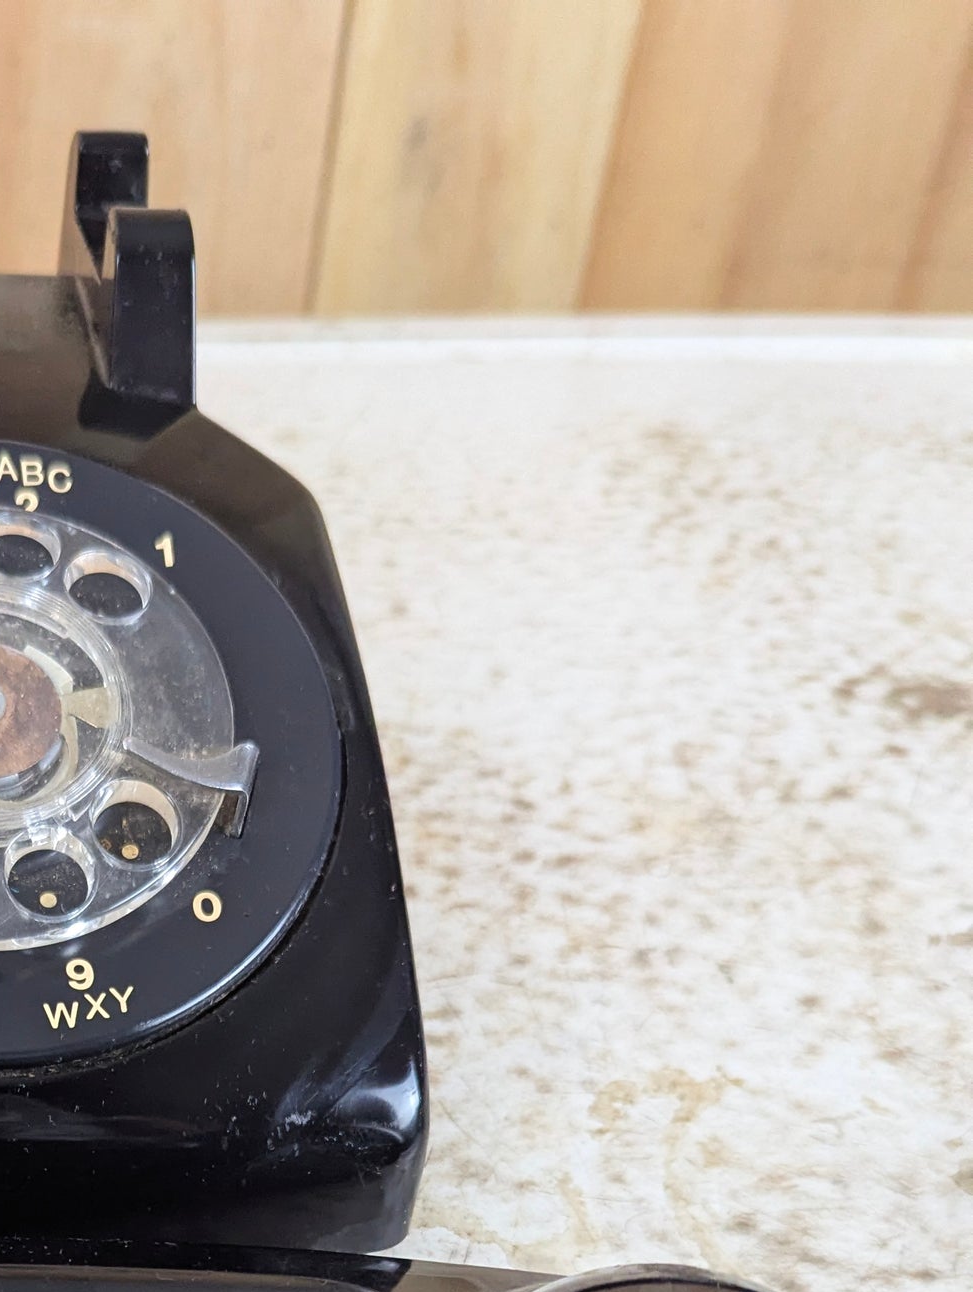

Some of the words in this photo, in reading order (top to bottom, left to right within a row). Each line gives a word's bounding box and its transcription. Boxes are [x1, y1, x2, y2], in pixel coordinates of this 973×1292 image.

[153, 531, 176, 568] 1
[64, 957, 95, 991] 9
[42, 985, 135, 1030] WXY
